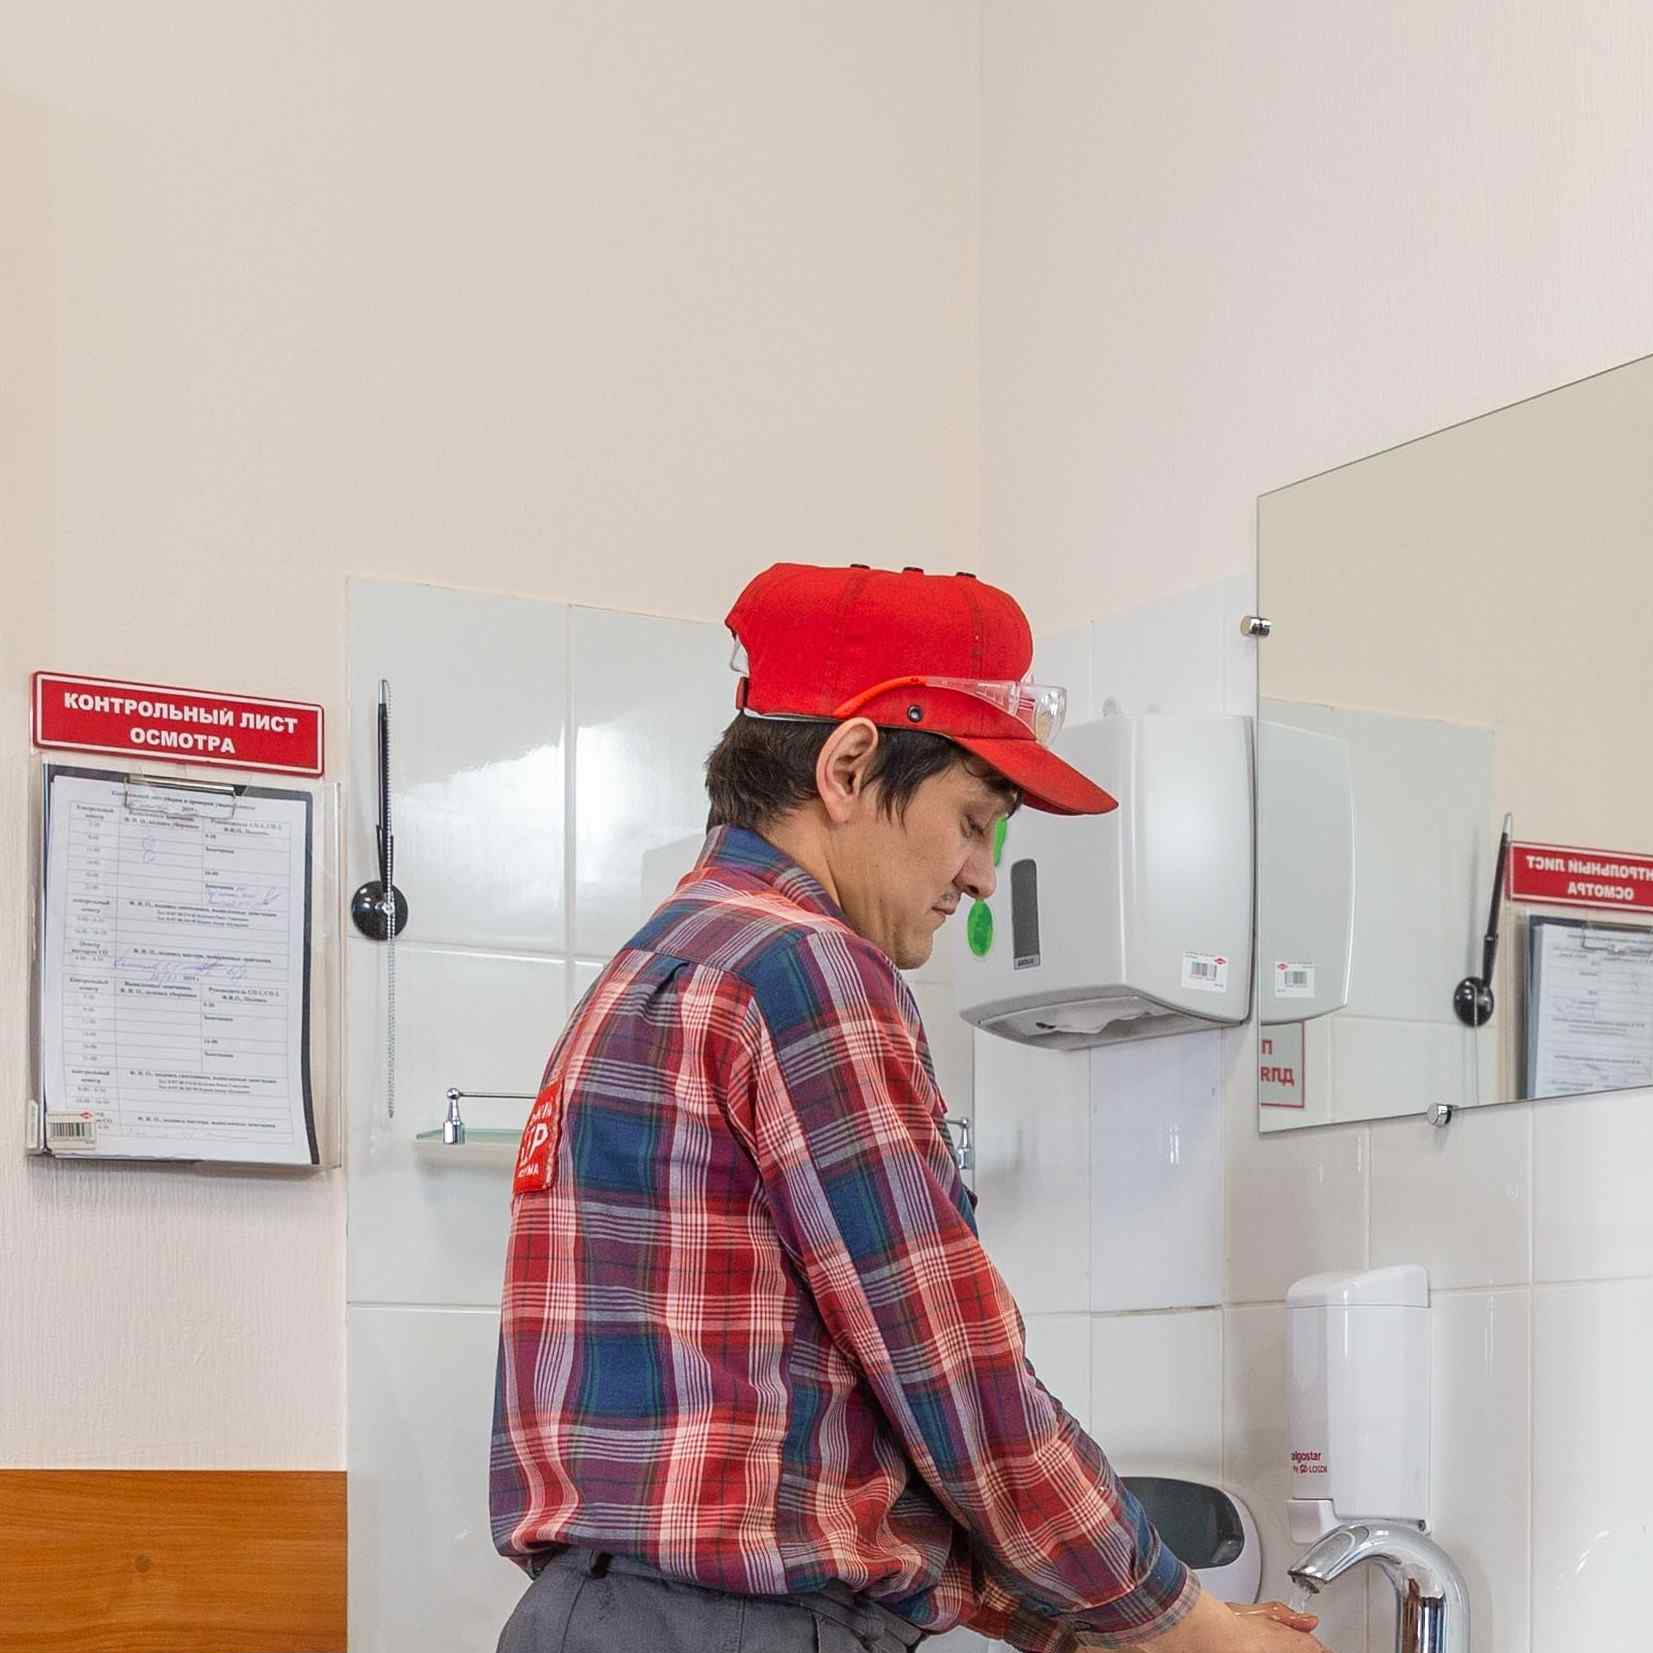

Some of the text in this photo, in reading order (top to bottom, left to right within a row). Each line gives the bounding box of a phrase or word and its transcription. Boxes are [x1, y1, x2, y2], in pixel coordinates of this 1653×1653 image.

[64, 692, 299, 734] КОНТРОЛЬНЫЙ ЛИСТ
[129, 727, 236, 754] ОСМОТРА
